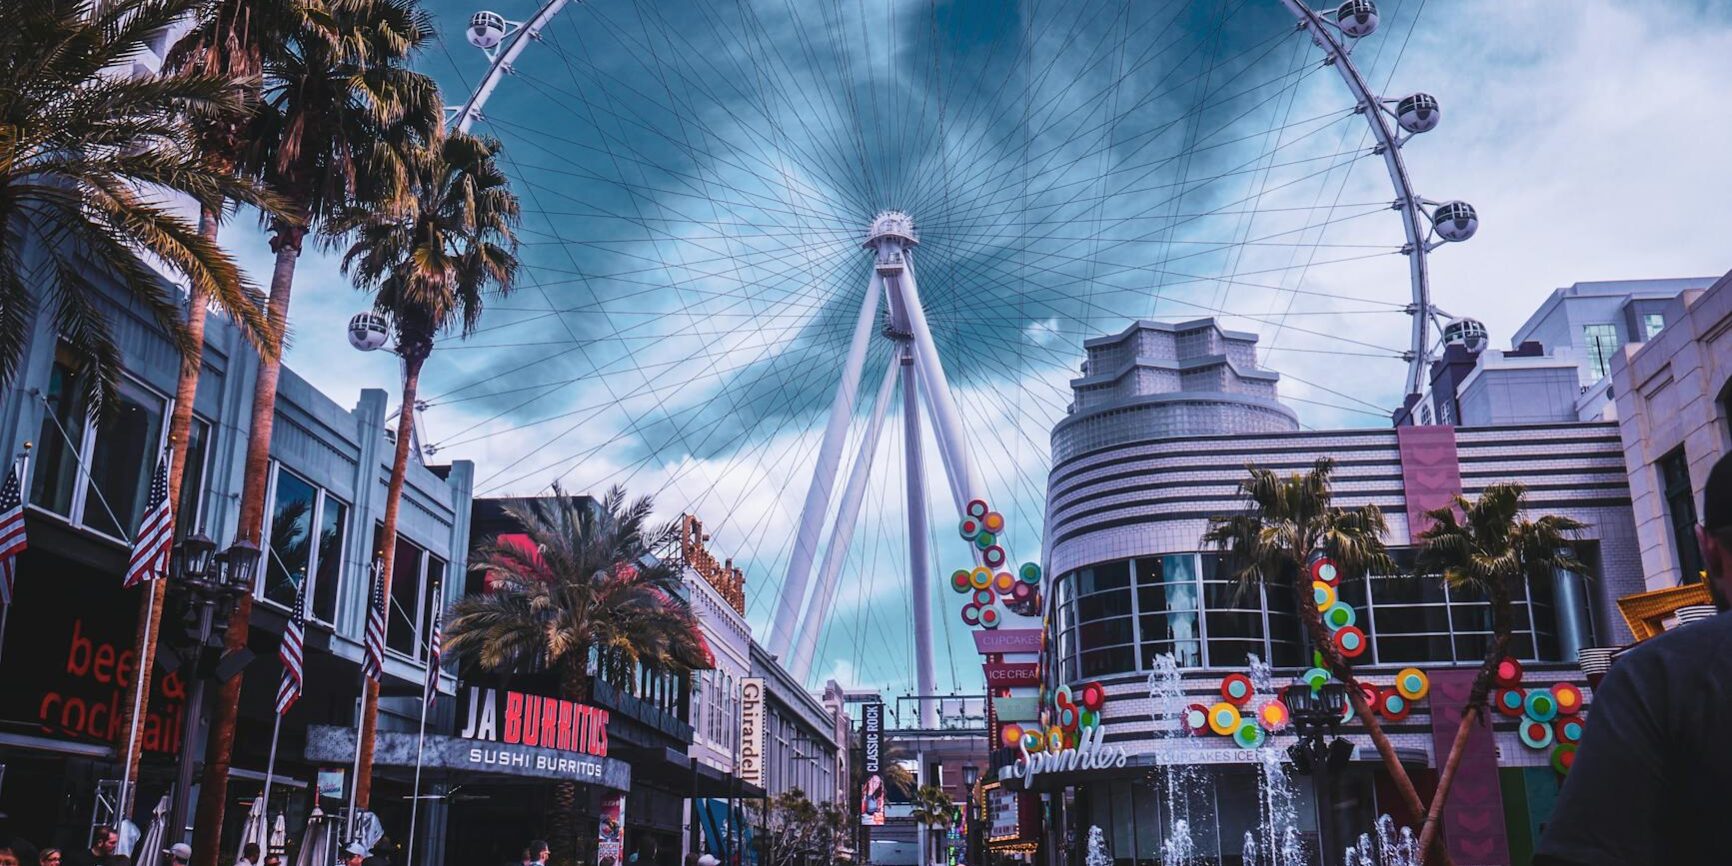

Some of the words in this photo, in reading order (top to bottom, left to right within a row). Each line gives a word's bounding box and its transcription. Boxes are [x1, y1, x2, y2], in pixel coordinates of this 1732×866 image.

[66, 617, 134, 688] bee
[982, 634, 1042, 646] CUPCAKES
[989, 669, 1006, 680] ICE
[1007, 669, 1039, 680] CREA
[38, 688, 184, 754] cockail
[461, 686, 497, 741] JA
[503, 690, 610, 758] BURRITOS
[741, 682, 760, 788] Ghirardell
[866, 704, 879, 732] ROCK
[469, 748, 530, 768] SUSHI
[536, 755, 603, 777] BURRITOS
[866, 734, 879, 773] CLASSIC
[1012, 724, 1128, 790] Sprinkles
[1161, 750, 1231, 763] CUPCAKES
[1234, 749, 1254, 762] ICE
